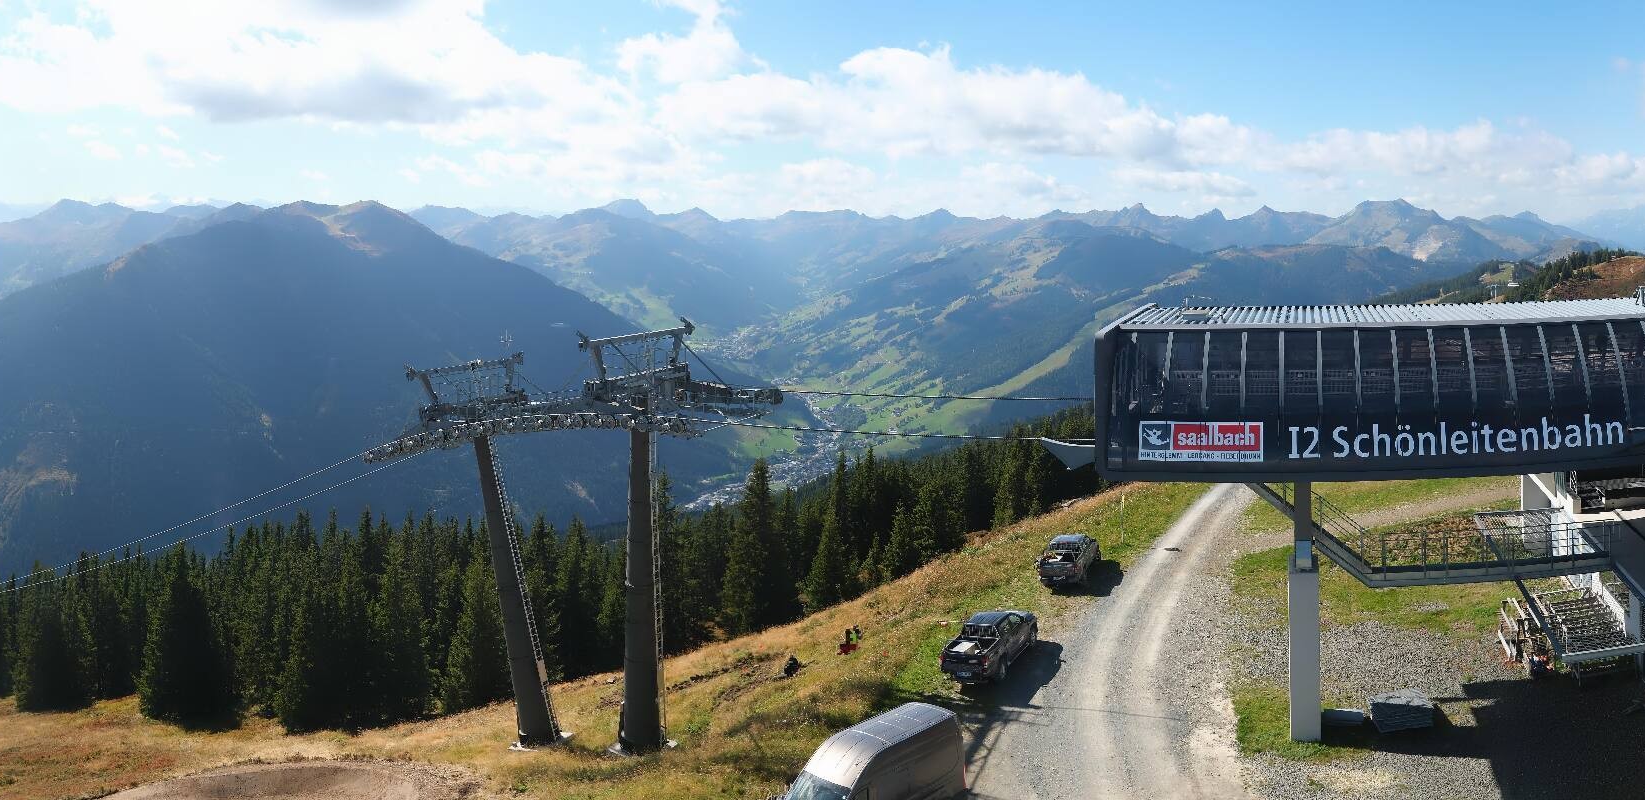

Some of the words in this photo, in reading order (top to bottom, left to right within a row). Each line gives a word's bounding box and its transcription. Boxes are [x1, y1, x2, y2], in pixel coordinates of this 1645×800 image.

[1177, 424, 1255, 446] saalbach
[1287, 426, 1321, 459] I2
[1332, 413, 1624, 458] Schönleitenbahn
